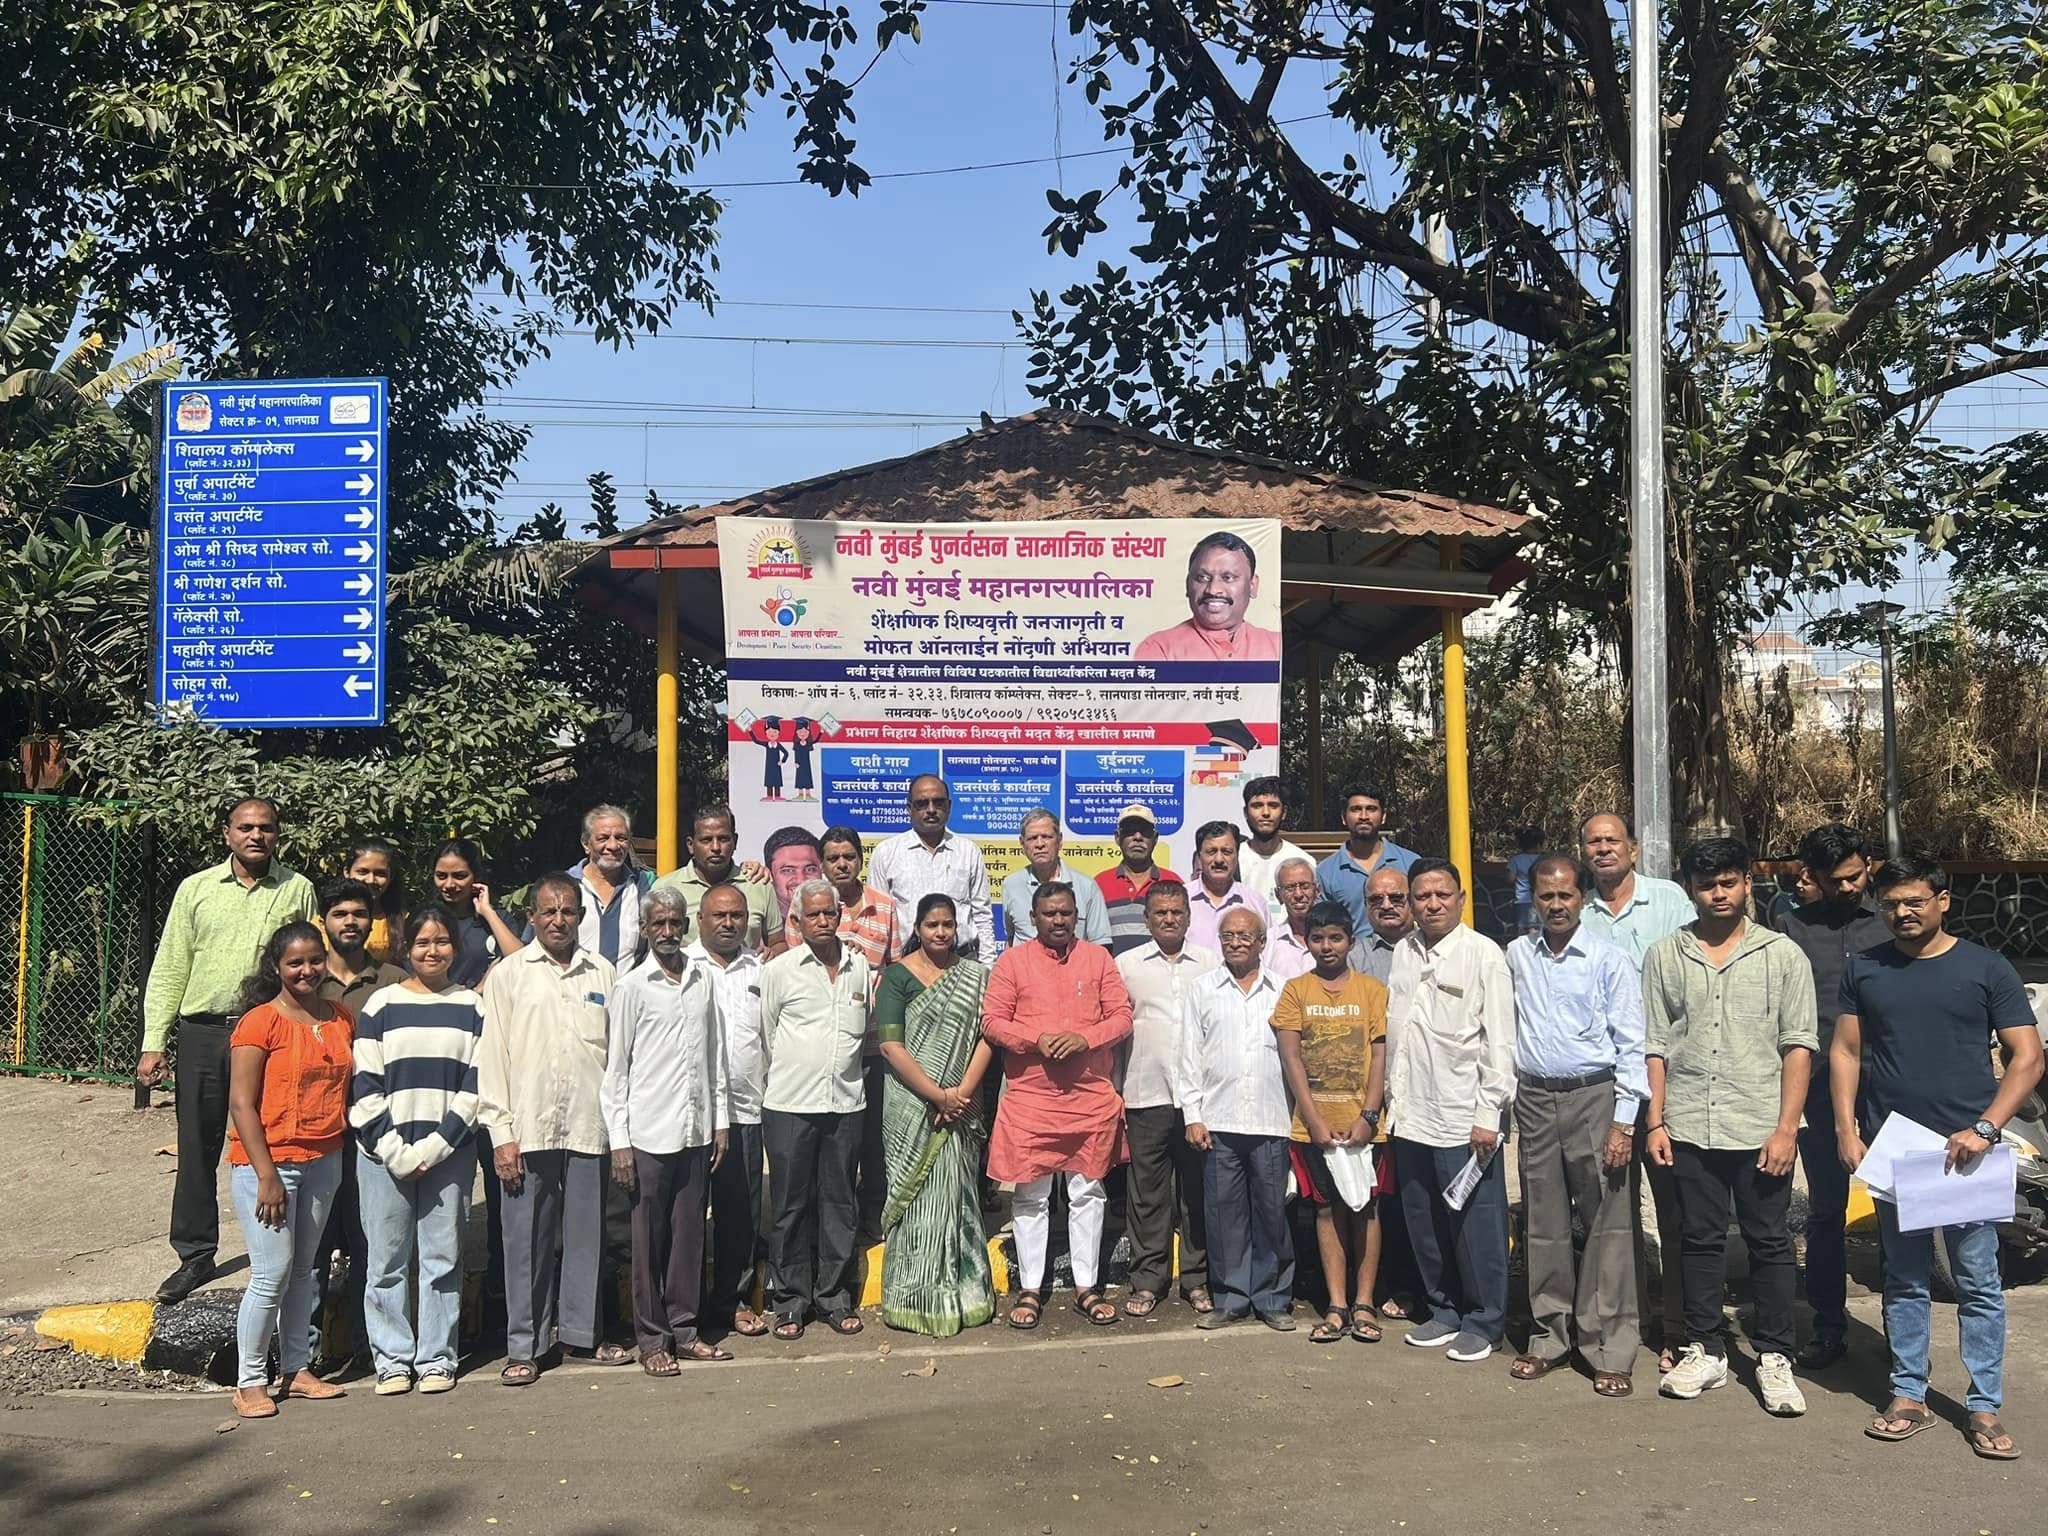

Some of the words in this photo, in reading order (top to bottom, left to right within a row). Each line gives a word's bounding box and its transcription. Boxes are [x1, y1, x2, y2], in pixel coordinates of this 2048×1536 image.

[219, 397, 234, 408] नवी
[238, 394, 256, 411] मुंबई
[259, 394, 321, 409] महानगरपालिका
[219, 416, 244, 427] सेक्टर
[284, 415, 319, 425] सानपाडा
[175, 442, 225, 456] शिवालय
[185, 459, 208, 468] (प्लॉट
[210, 459, 220, 467] नं.
[175, 474, 198, 494] पुर्वा
[203, 474, 256, 489] अपार्टमेंट
[184, 492, 207, 502] (प्लॉट
[222, 492, 236, 501] ३०)
[174, 508, 204, 523] वसंत
[210, 507, 263, 522] अपार्टमेंट
[184, 526, 207, 535] (प्लॉट
[210, 526, 218, 534] नं.
[174, 541, 200, 556] ओम
[206, 540, 220, 556] श्री
[226, 540, 257, 556] सिध्द
[263, 539, 308, 556] रामेश्वर
[313, 539, 332, 554] सो.
[835, 529, 873, 556] नवी
[879, 530, 924, 563] मुंबई
[930, 530, 1009, 564] पुनर्वसन
[1015, 531, 1105, 558] सामाजिक
[1111, 532, 1166, 558] संस्था
[183, 558, 206, 568] (प्लॉट
[221, 559, 235, 568] २८)
[174, 574, 189, 590] श्री
[194, 574, 226, 589] गणेश
[231, 573, 261, 590] दर्शन
[266, 573, 287, 588] सो.
[852, 570, 898, 597] नवी
[906, 569, 961, 606] मुंबई
[968, 571, 1154, 602] महानगरपालिका
[183, 592, 205, 602] (प्लॉट
[208, 593, 217, 601] नं.
[173, 607, 219, 623] गॅलेक्सी
[224, 607, 244, 622] सो.
[871, 609, 939, 631] शैक्षणिक
[944, 610, 1018, 635] शिष्यवृत्ती
[1023, 611, 1105, 635] जनजागृती
[1111, 616, 1124, 630] व
[183, 626, 205, 635] (प्लॉट
[208, 626, 216, 634] नं.
[172, 640, 215, 658] महावीर
[221, 640, 274, 656] अपार्टमेंट
[864, 635, 912, 655] मोफत
[919, 636, 997, 658] ऑनलाईन
[1004, 636, 1055, 659] नोंदणी
[1062, 636, 1131, 656] अभियान
[182, 659, 204, 669] (प्लॉट
[846, 665, 867, 677] नवी
[869, 664, 895, 680] मुंबई
[898, 664, 941, 677] क्षेत्रातील
[944, 666, 976, 678] विविध
[979, 666, 1029, 678] घटकातील
[1110, 668, 1134, 679] मदत
[1137, 665, 1156, 680] केंद्र
[171, 674, 206, 691] सोहम
[211, 674, 231, 689] सो.
[208, 693, 216, 701] नं.
[808, 685, 828, 698] शॉप
[863, 685, 886, 699] प्लॉट
[951, 686, 991, 700] शिवालय
[1100, 688, 1141, 700] सानपाडा
[1193, 688, 1212, 700] नवी
[846, 727, 878, 739] प्रभाग
[882, 725, 917, 739] निहाय
[921, 726, 968, 739] शैक्षणिक
[971, 726, 1021, 742] शिष्यवृत्ती
[1025, 729, 1051, 741] मदत
[1055, 726, 1074, 741] केंद्र
[1078, 727, 1119, 739] खालील
[1123, 726, 1156, 740] प्रमाणे
[850, 754, 881, 768] वाशी
[885, 756, 910, 768] गाव
[947, 756, 981, 764] सानपाडा
[1096, 751, 1145, 769] जुईनगर
[832, 778, 879, 791] जनसंपर्क
[953, 779, 1000, 792] जनसंपर्क
[1004, 780, 1051, 792] कार्यालय
[1076, 780, 1123, 793] जनसंपर्क
[1127, 780, 1174, 793] कार्यालय
[1063, 846, 1103, 857] जानेवारी
[1306, 1005, 1346, 1016] WELCOME
[1349, 1005, 1360, 1016] TO
